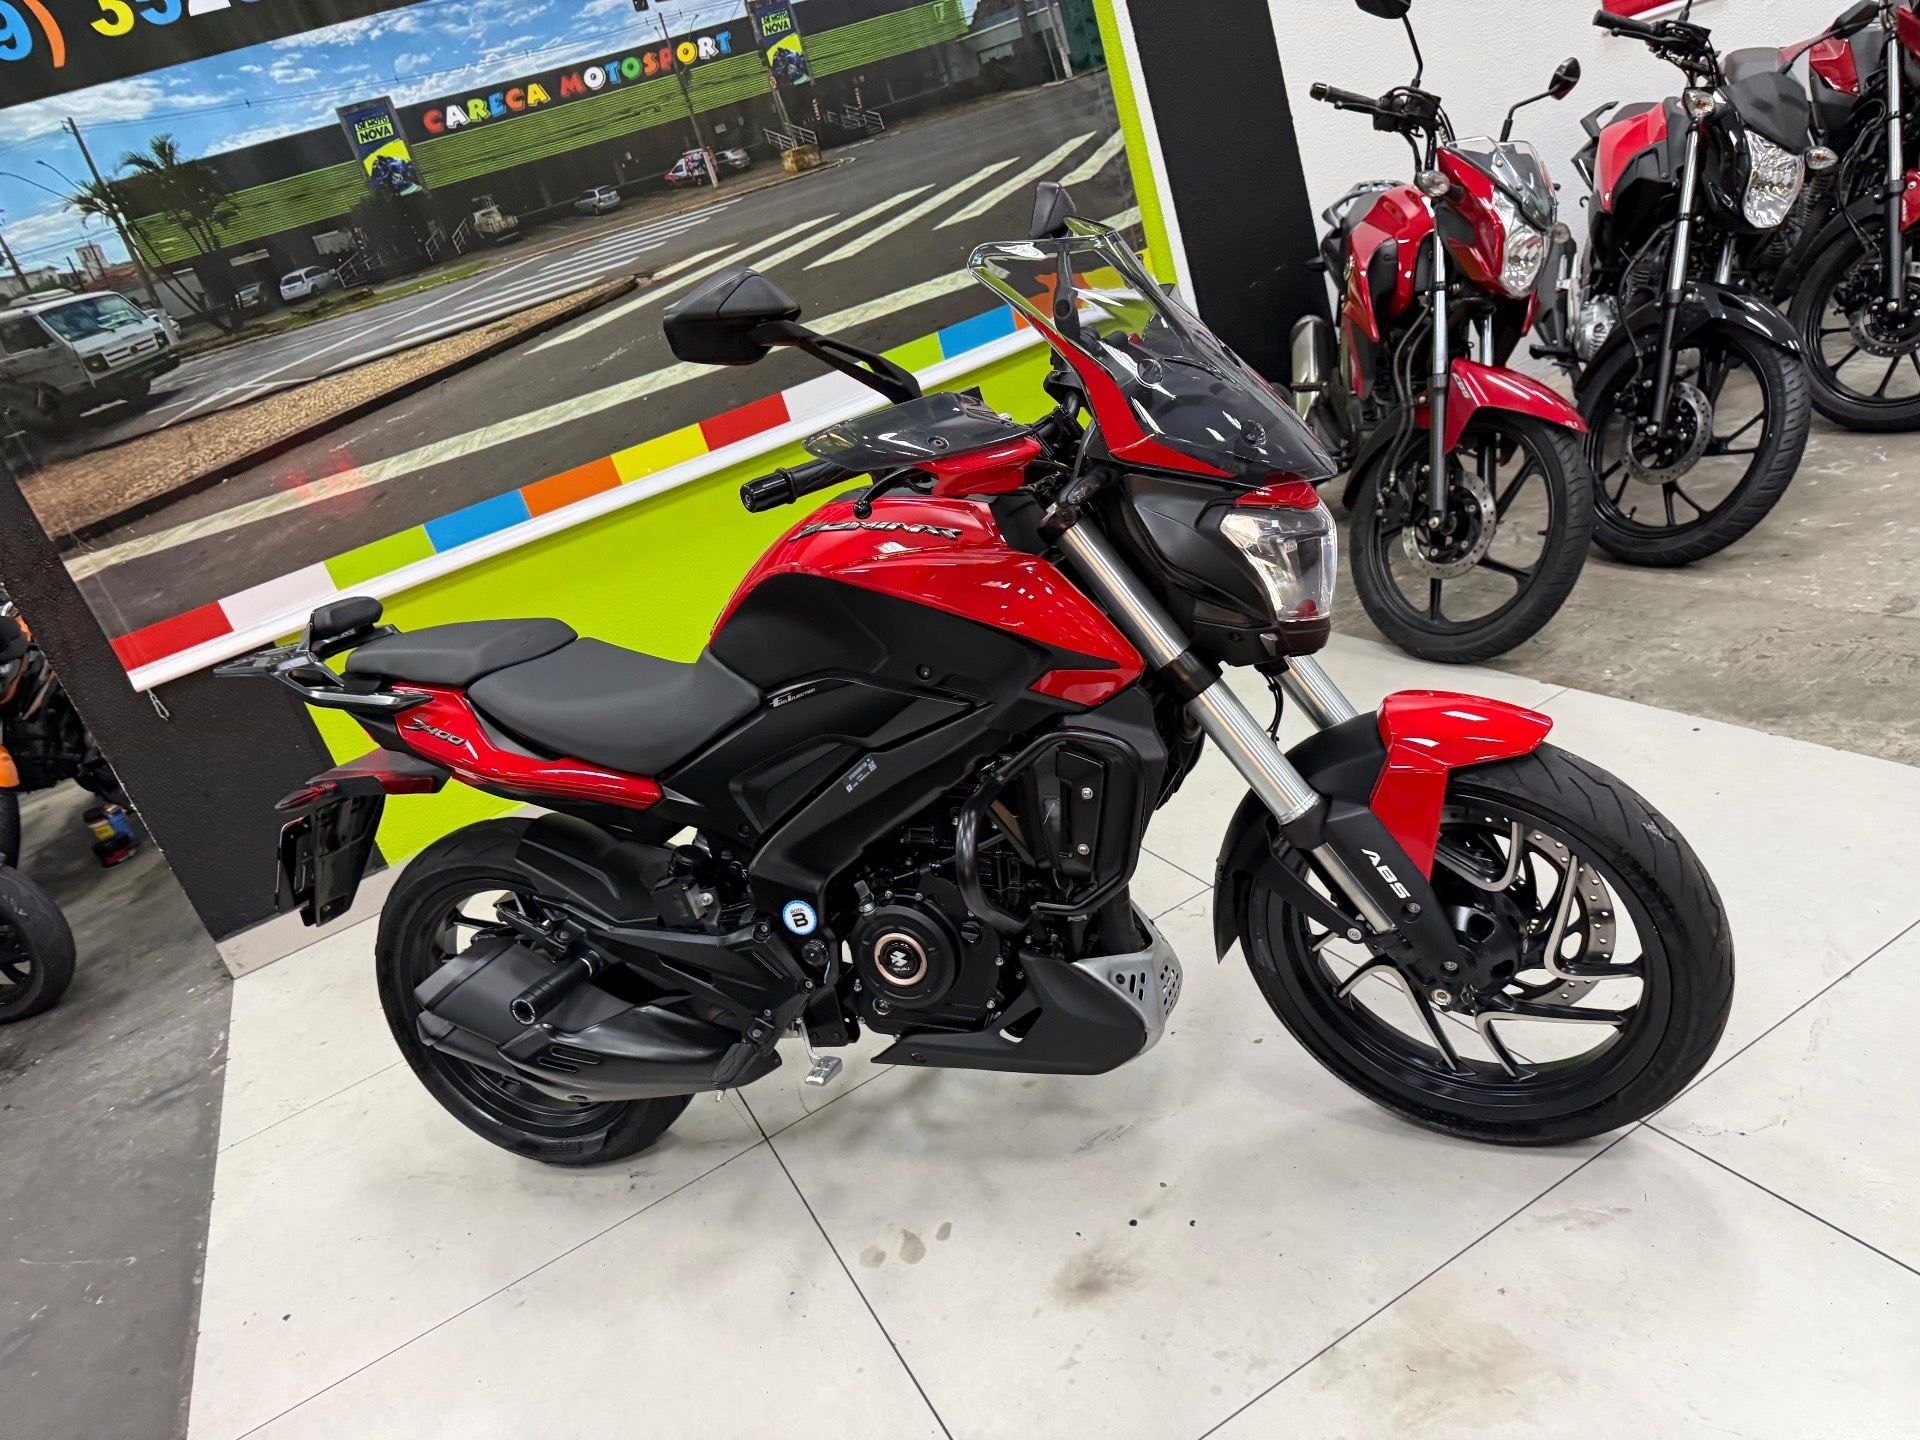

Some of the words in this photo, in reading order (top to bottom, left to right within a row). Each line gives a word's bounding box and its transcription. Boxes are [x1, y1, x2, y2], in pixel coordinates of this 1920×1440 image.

[764, 20, 790, 34] NOVA
[423, 83, 551, 134] CARECA
[560, 31, 731, 98] MOTOSPORT
[368, 116, 387, 125] MOTO
[359, 126, 391, 142] NOVA
[1361, 848, 1411, 898] ABS
